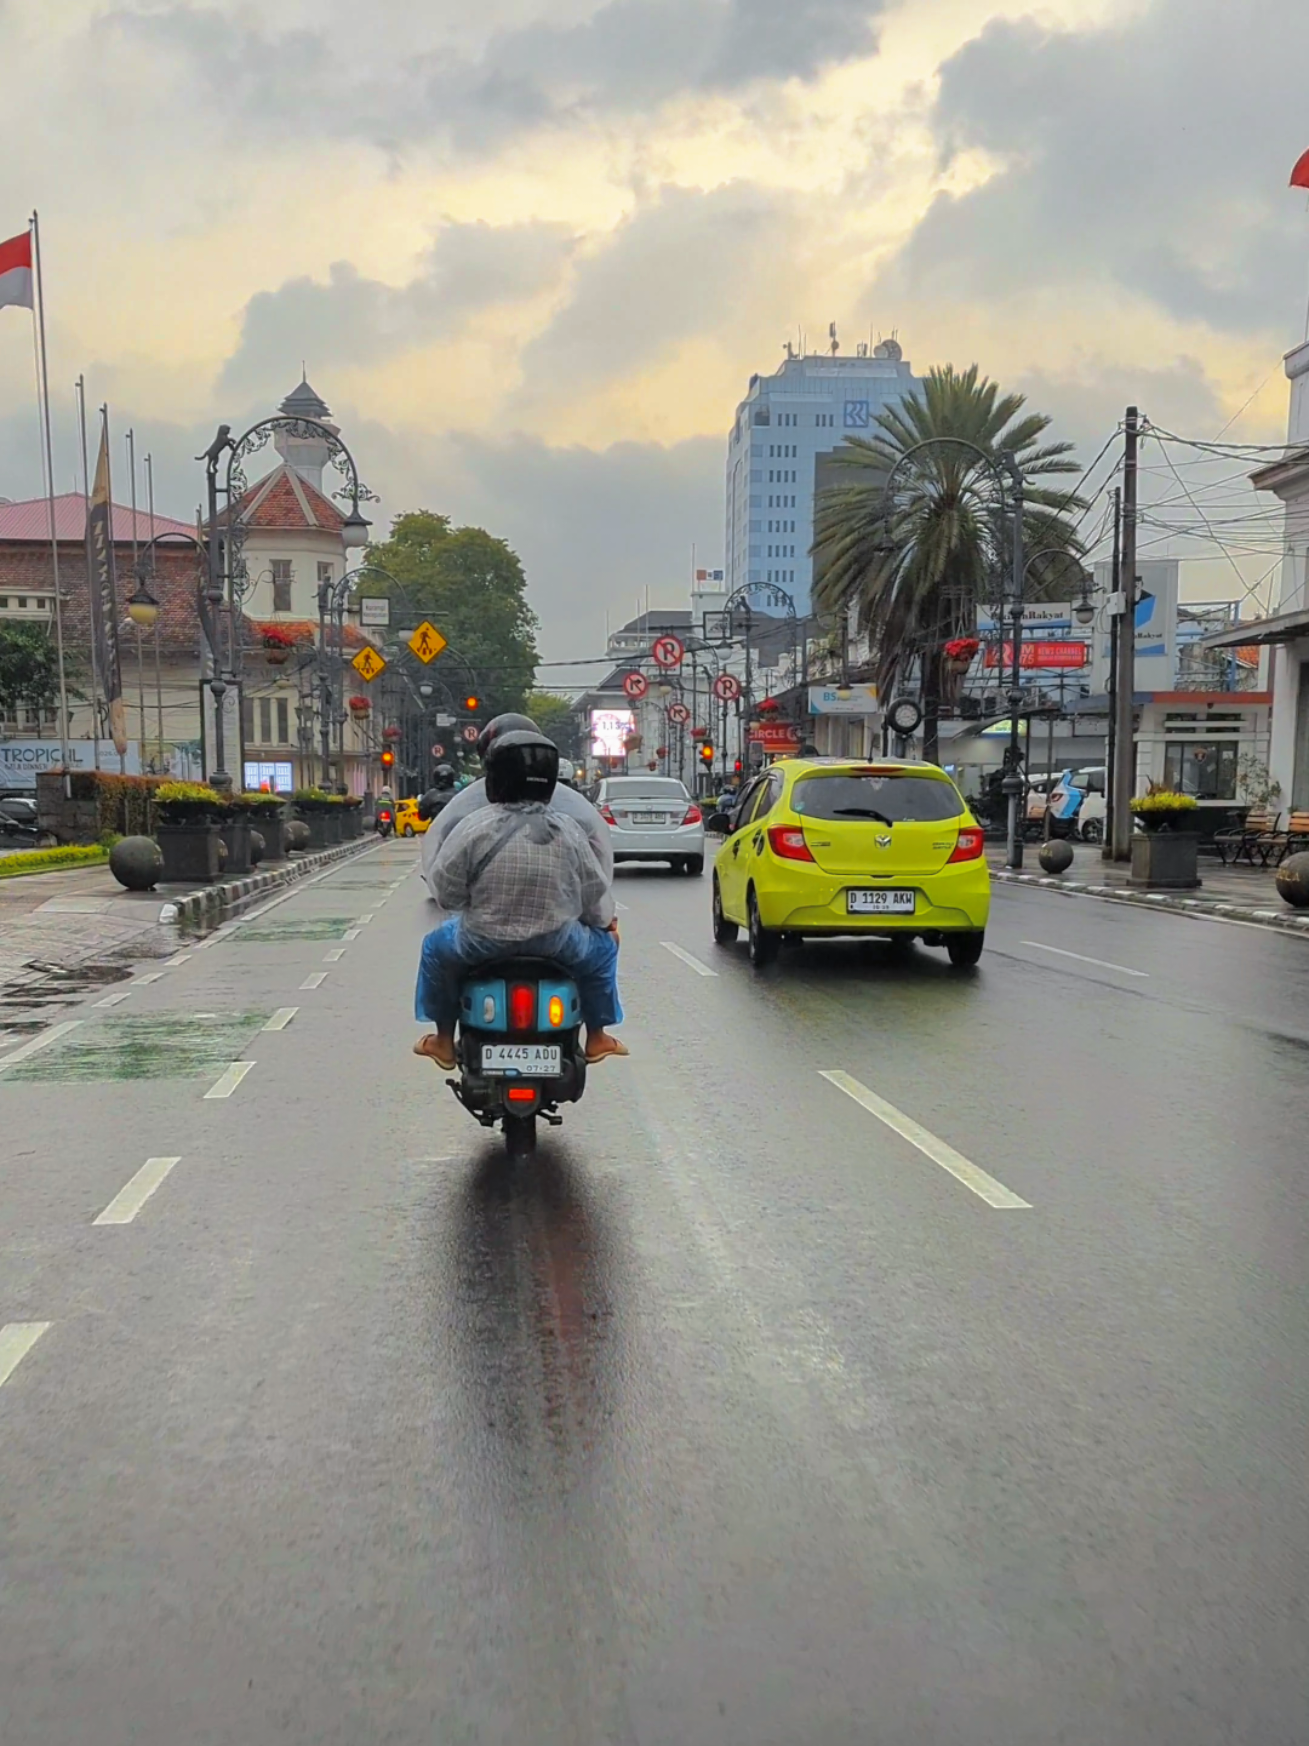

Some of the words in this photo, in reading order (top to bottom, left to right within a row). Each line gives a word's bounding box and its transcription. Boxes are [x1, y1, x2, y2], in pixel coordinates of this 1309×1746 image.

[749, 728, 785, 739] CIRCLE
[850, 892, 857, 904] D
[862, 892, 888, 904] 1129
[893, 892, 912, 905] AKW
[485, 1048, 493, 1060] D
[498, 1047, 529, 1060] 4445
[534, 1048, 557, 1060] ADU
